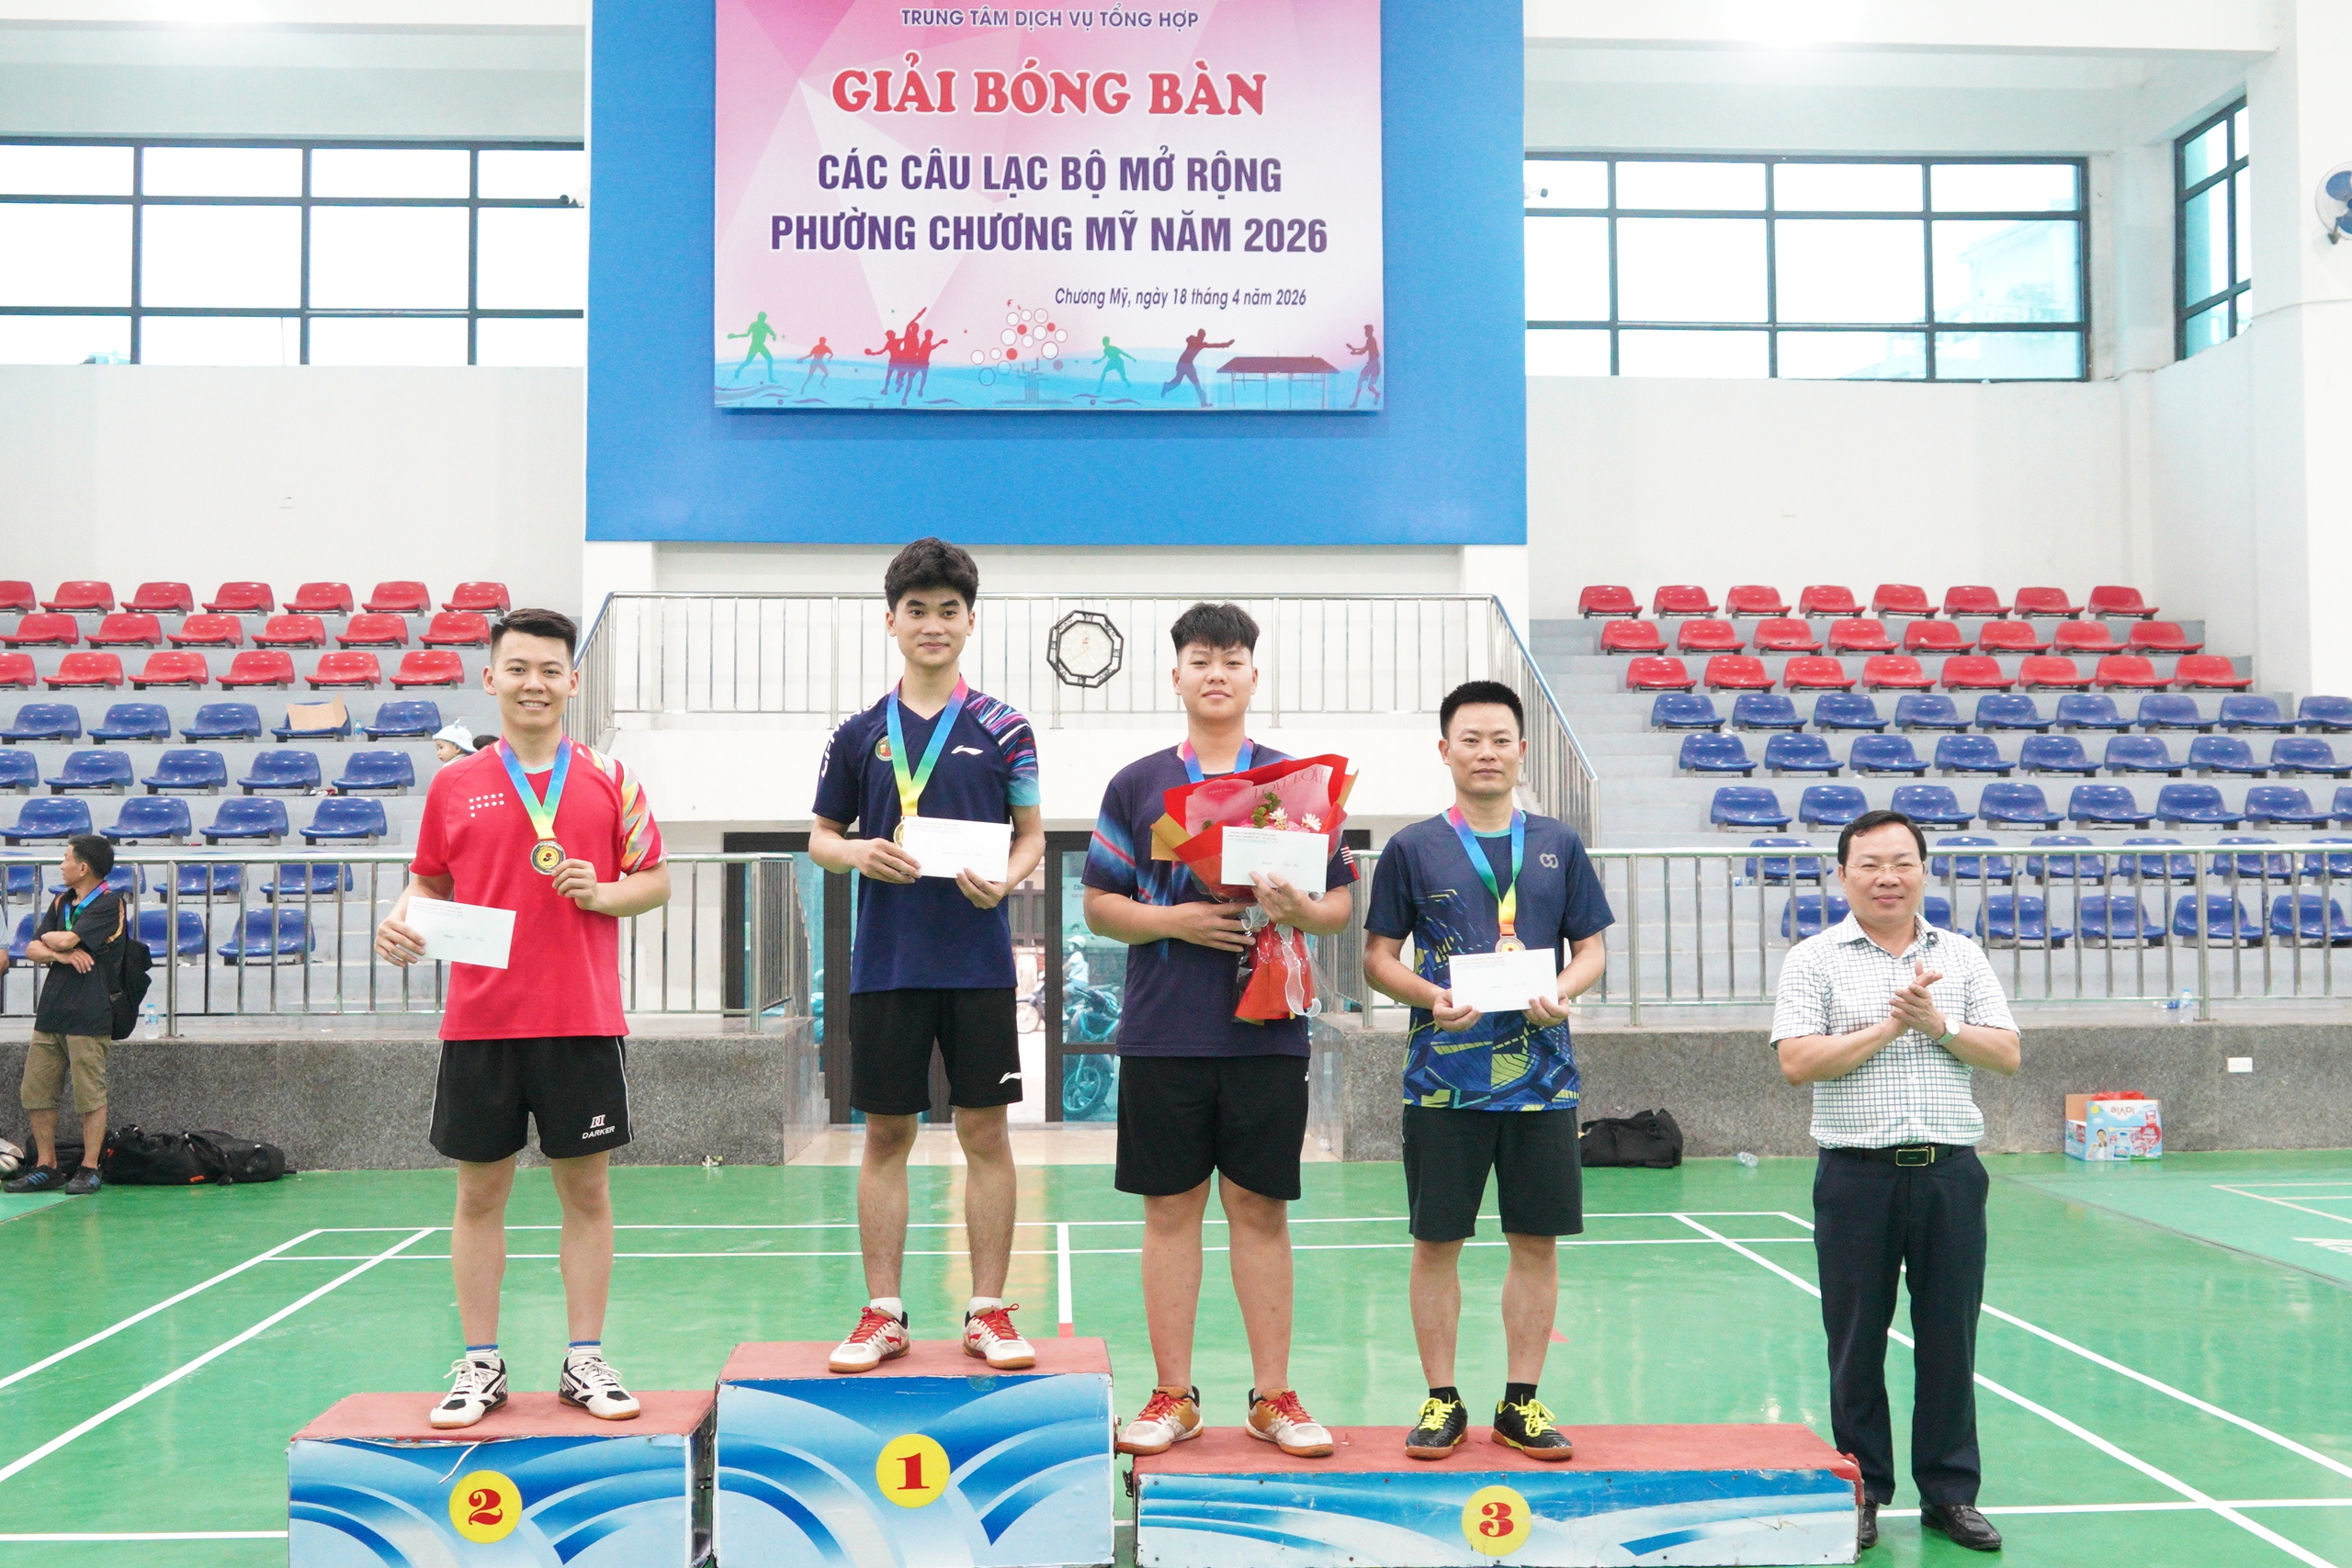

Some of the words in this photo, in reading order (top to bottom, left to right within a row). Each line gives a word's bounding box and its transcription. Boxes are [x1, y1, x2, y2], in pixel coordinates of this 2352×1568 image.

[901, 9, 964, 26] TRUNG
[970, 6, 1009, 26] TÂM
[1015, 11, 1062, 30] DỊCH
[1069, 11, 1093, 31] VỤ
[1100, 3, 1152, 27] TỔNG
[1159, 12, 1199, 32] HỢP
[832, 52, 956, 114] GIẢI
[974, 60, 1130, 115] BÓNG
[1149, 61, 1266, 116] BÀN
[819, 147, 888, 190] CÁC
[901, 147, 970, 190] CÂU
[984, 155, 1047, 198] LẠC
[1061, 149, 1106, 199] BỘ
[1120, 145, 1175, 192] MỞ
[1187, 150, 1282, 200] RỘNG
[771, 207, 916, 251] PHƯỜNG
[929, 212, 1072, 252] CHƯƠNG
[1086, 209, 1138, 251] MỸ
[1151, 209, 1231, 252] NĂM
[1244, 218, 1328, 254] 2026
[1056, 288, 1105, 310] Chương
[1109, 287, 1131, 309] Mỹ,
[1136, 288, 1169, 310] ngày
[1173, 288, 1187, 304] 18
[1191, 288, 1228, 310] tháng
[1232, 288, 1239, 304] 4
[1243, 288, 1272, 305] năm
[1276, 288, 1306, 305] 2026
[582, 1125, 616, 1140] DARKER
[898, 1452, 929, 1490] 1
[468, 1488, 503, 1526] 2
[1479, 1502, 1514, 1538] 3
